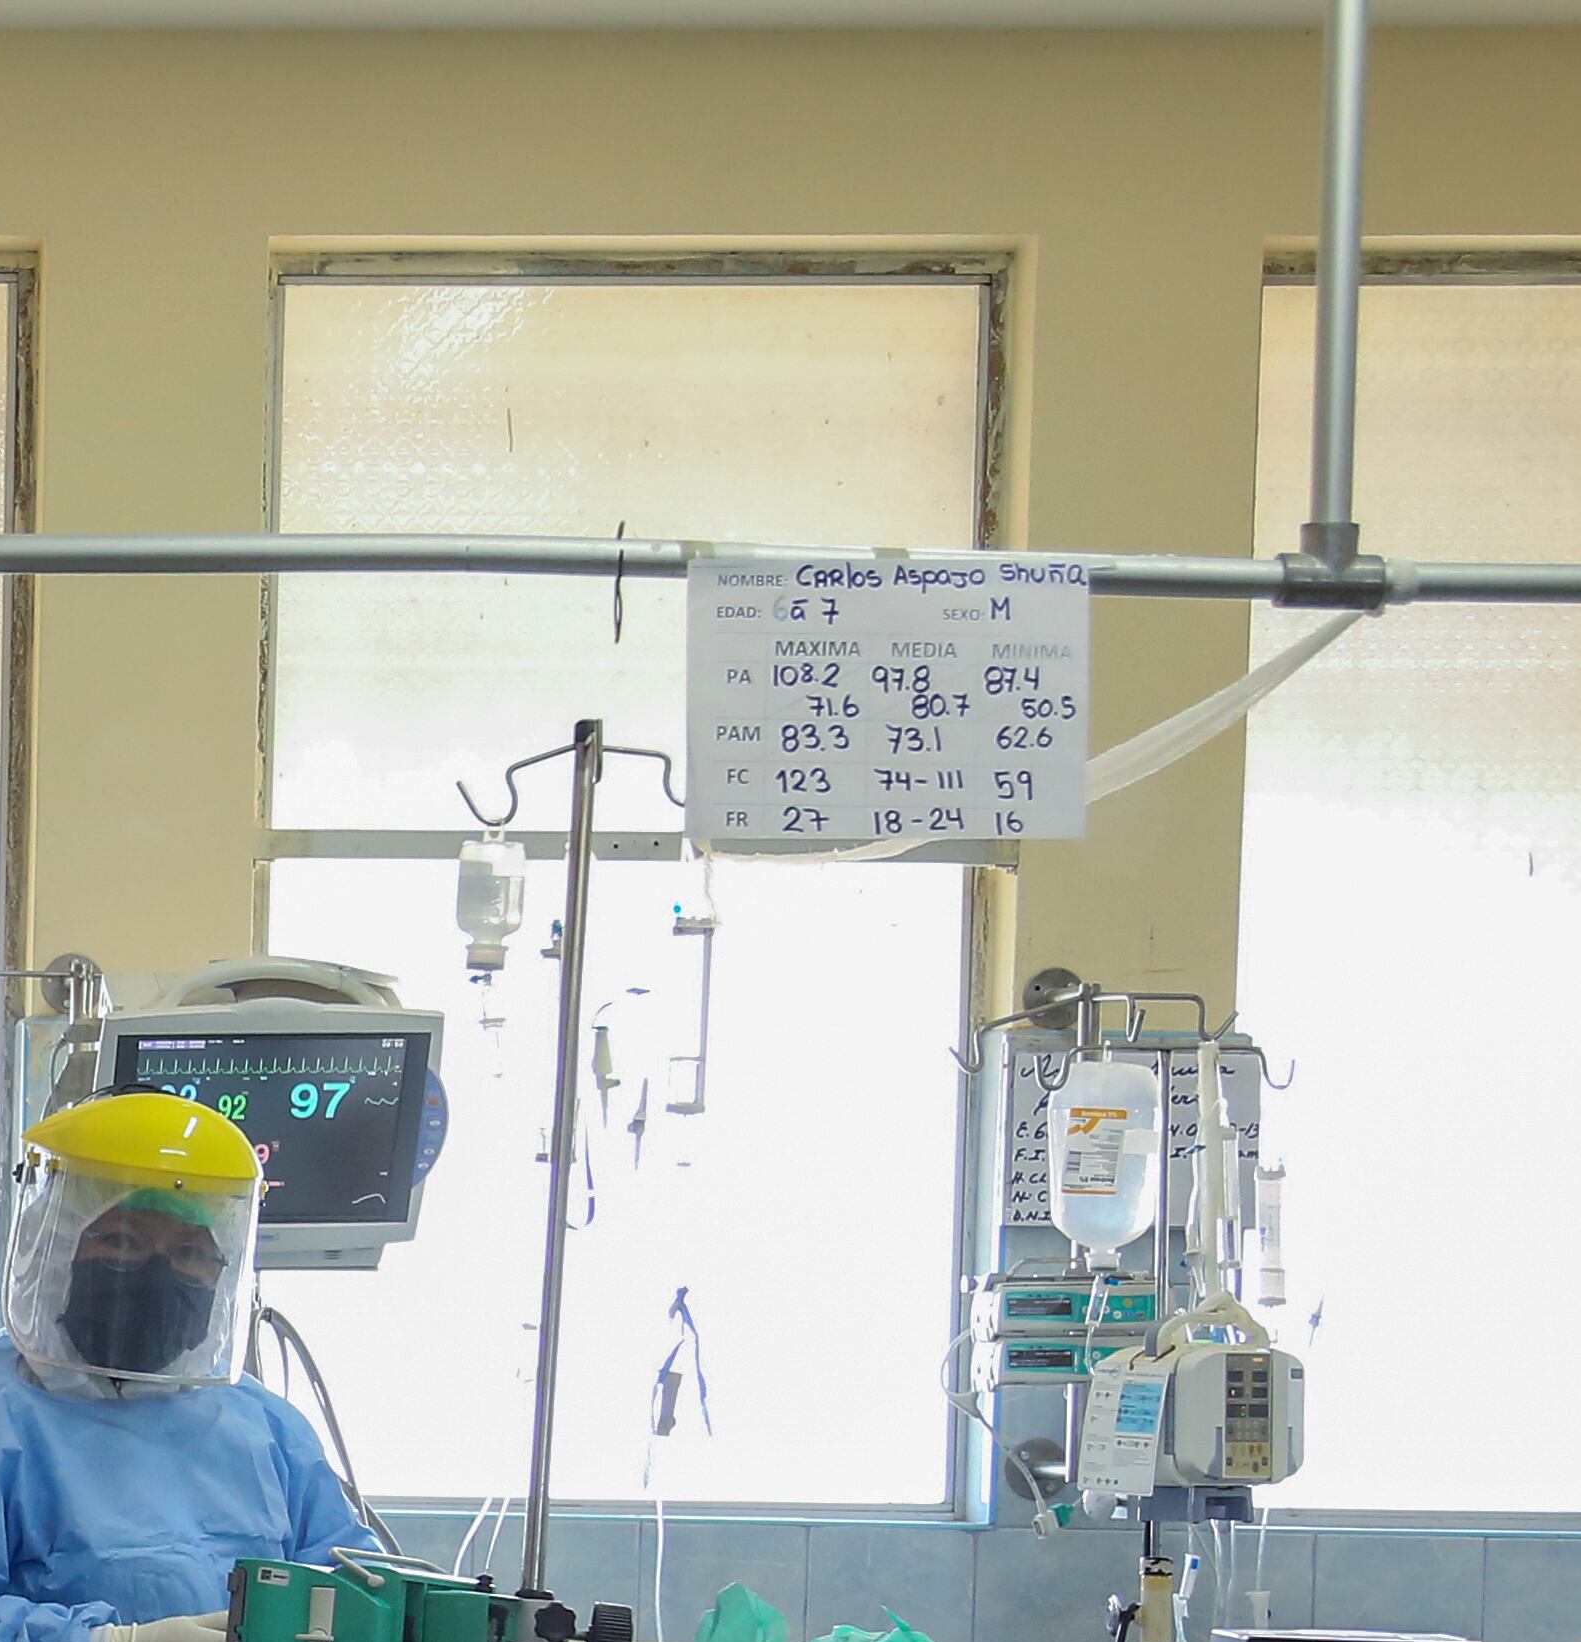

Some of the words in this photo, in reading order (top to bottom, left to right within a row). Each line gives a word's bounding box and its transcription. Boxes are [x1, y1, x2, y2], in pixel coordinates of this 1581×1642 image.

[717, 574, 788, 588] NOMBRE:
[716, 605, 761, 619] EDAD:
[942, 608, 985, 621] SEXO:
[989, 597, 1011, 621] M
[774, 641, 862, 657] MAXIMA
[891, 642, 957, 659] MEDIA
[992, 643, 1071, 660] MINIMA
[726, 669, 751, 685] PA
[773, 663, 840, 688] 108.2
[871, 665, 931, 694] 97.8
[983, 665, 1040, 695] 87.4
[805, 693, 860, 718] 71.6
[911, 693, 971, 719] 80.7
[1020, 696, 1077, 719] 50.5
[715, 725, 761, 742] PAM
[780, 724, 850, 754] 83.3
[886, 723, 942, 754] 73.1
[995, 725, 1053, 750] 62.6
[726, 769, 750, 784] FC
[774, 767, 832, 794] 123
[993, 770, 1033, 802] 59
[725, 810, 749, 827] FR
[782, 805, 830, 832] 27
[994, 810, 1024, 835] 16
[217, 1095, 247, 1120] 92
[290, 1083, 351, 1119] 97
